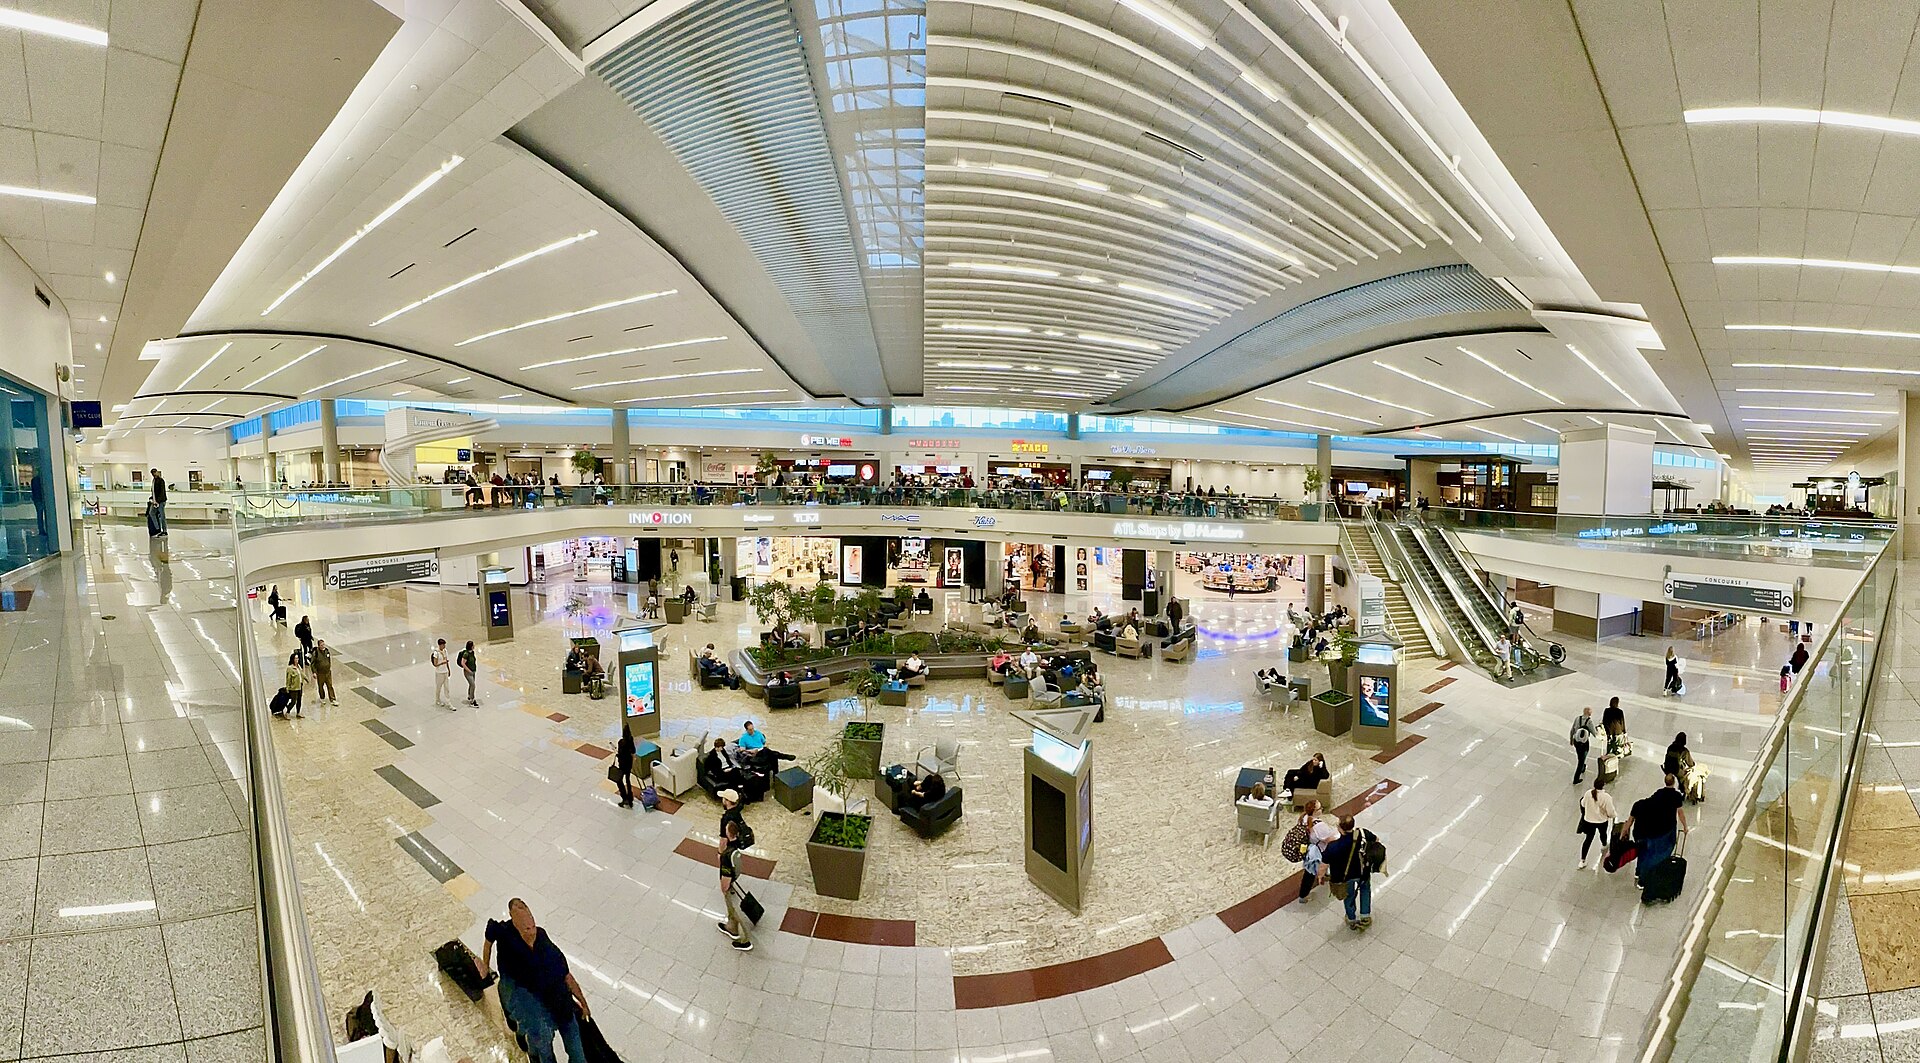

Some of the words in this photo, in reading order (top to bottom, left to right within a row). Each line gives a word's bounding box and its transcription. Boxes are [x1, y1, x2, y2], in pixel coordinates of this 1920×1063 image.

[811, 437, 824, 445] PEI
[825, 437, 840, 446] WEI
[1022, 443, 1049, 453] TACO
[1113, 522, 1137, 535] ATL
[1137, 522, 1167, 539] Shops
[1168, 524, 1182, 539] by
[366, 557, 399, 565] CONCOURSE
[1704, 577, 1741, 586] CONCOURSE
